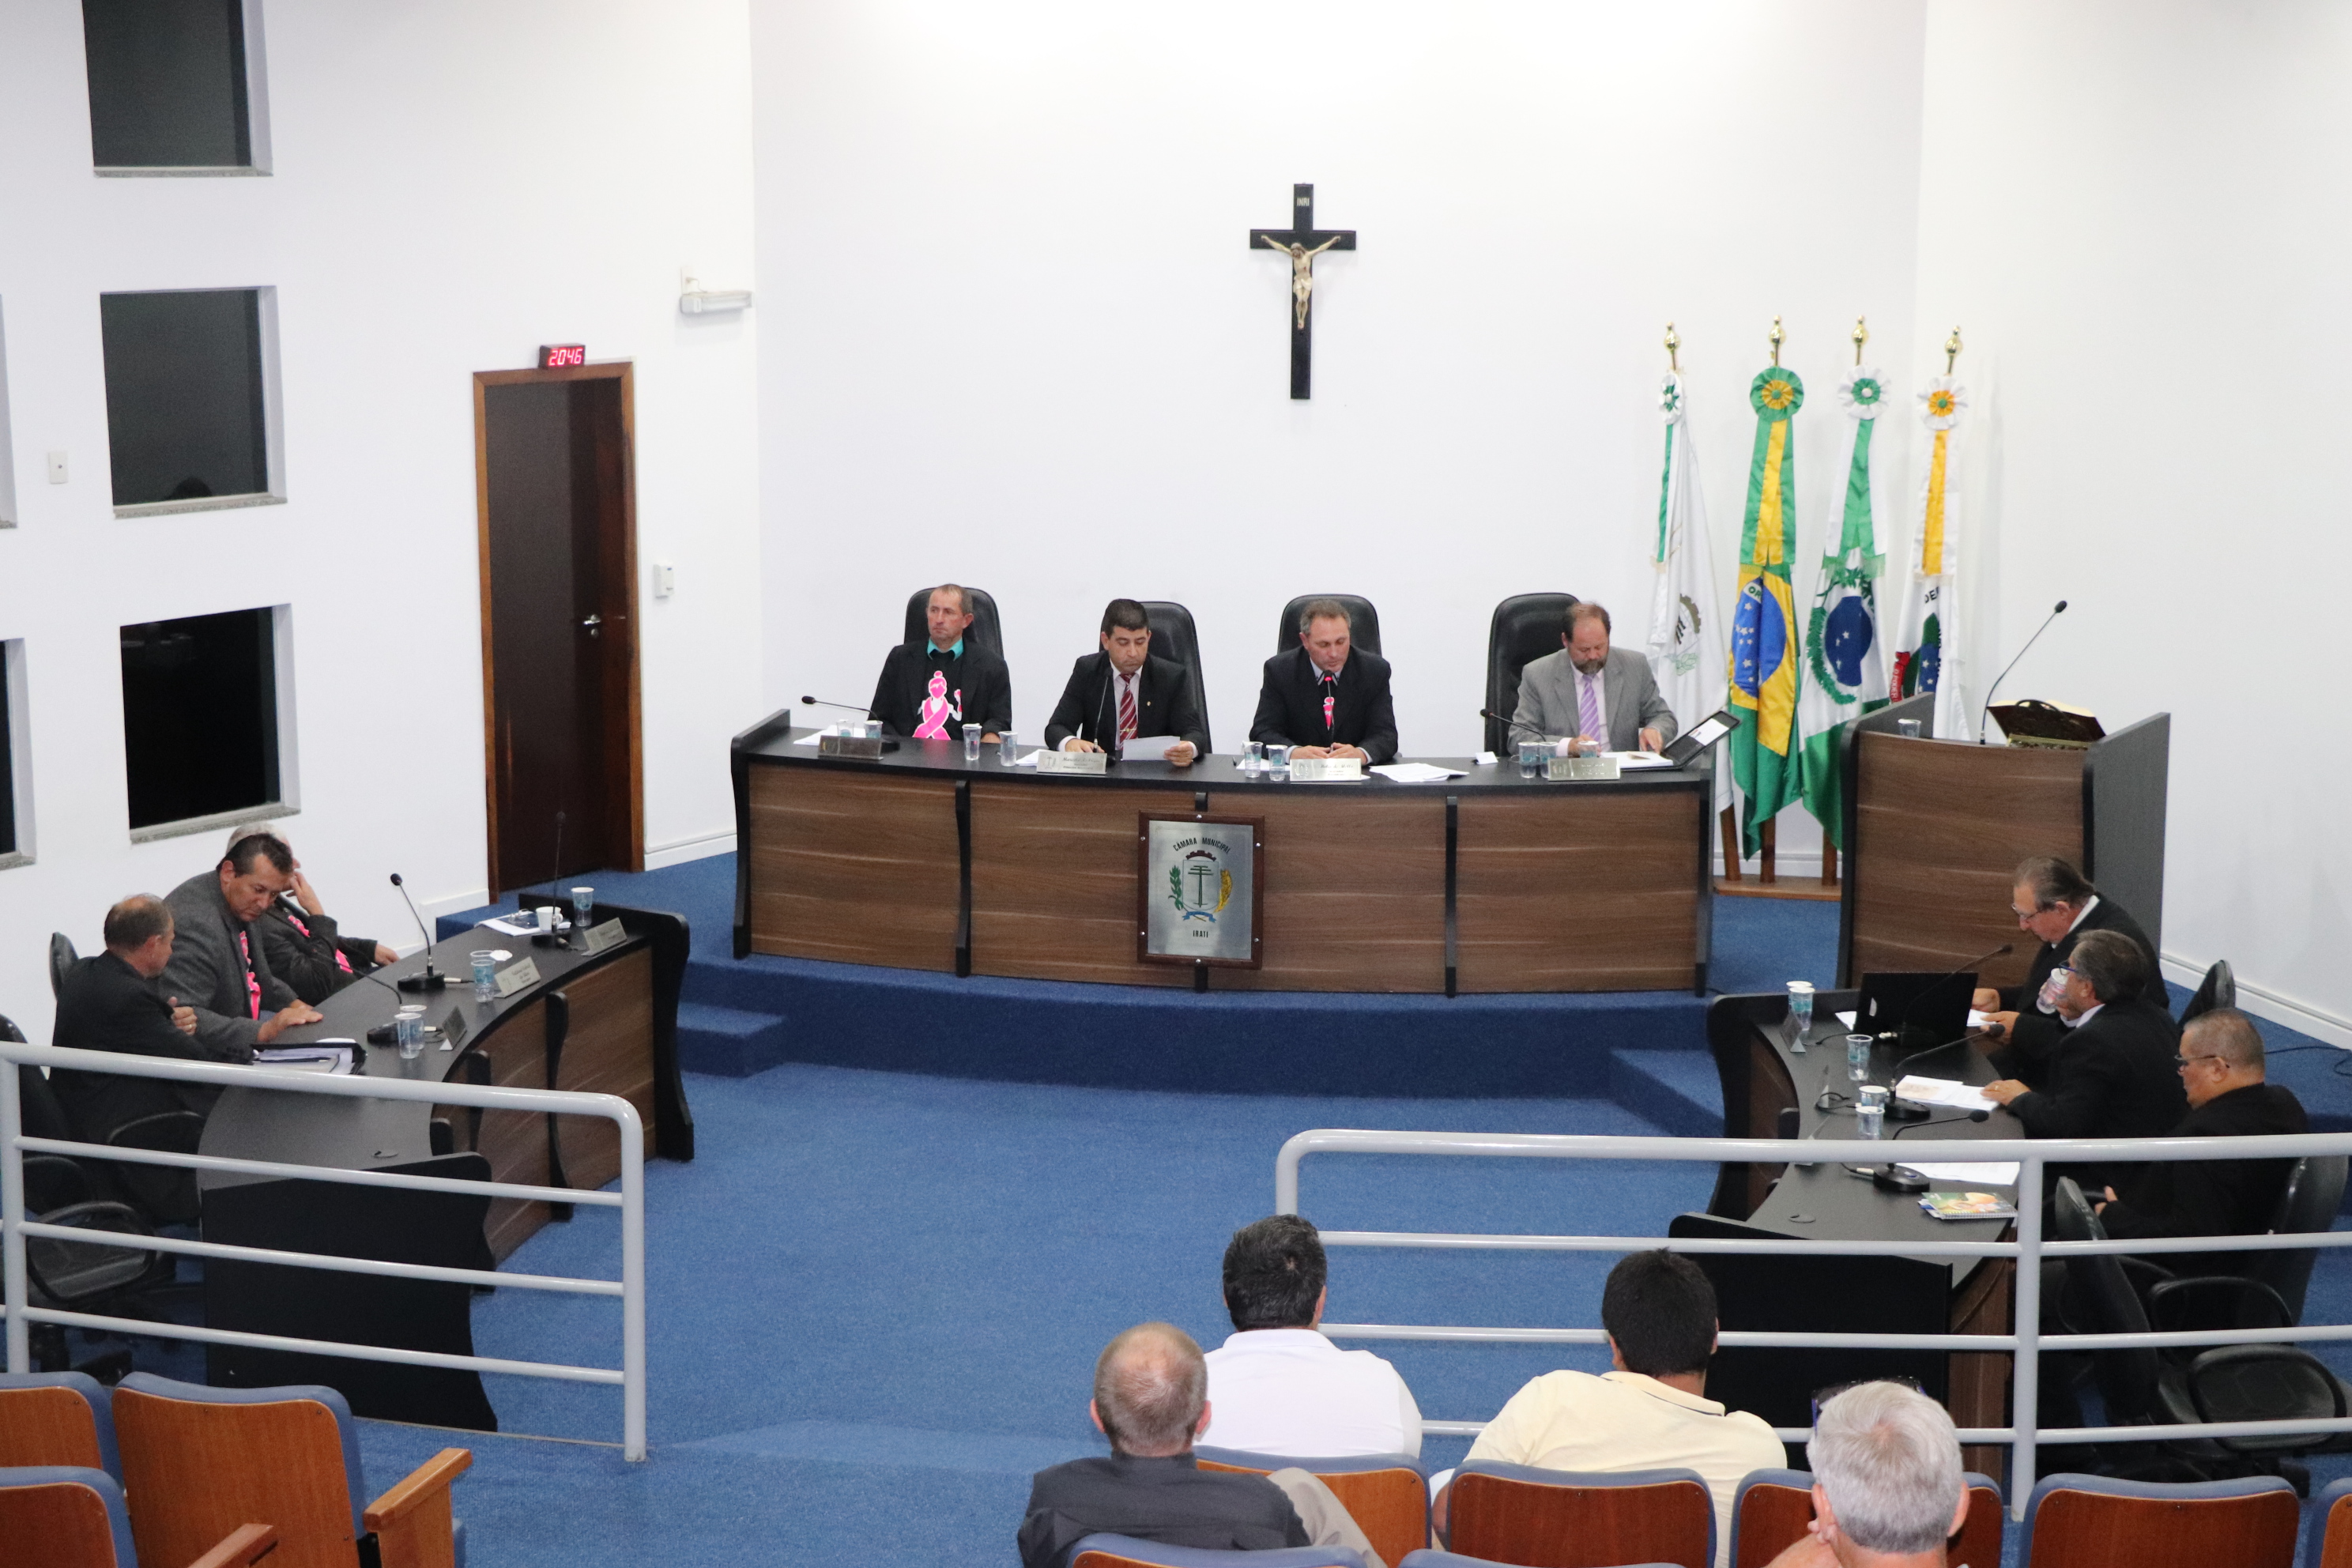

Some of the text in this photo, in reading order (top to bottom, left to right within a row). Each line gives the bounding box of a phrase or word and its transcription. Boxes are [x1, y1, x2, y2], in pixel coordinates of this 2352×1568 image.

[1296, 197, 1310, 207] INRI
[548, 349, 583, 366] 2046
[1193, 929, 1208, 938] IRATI
